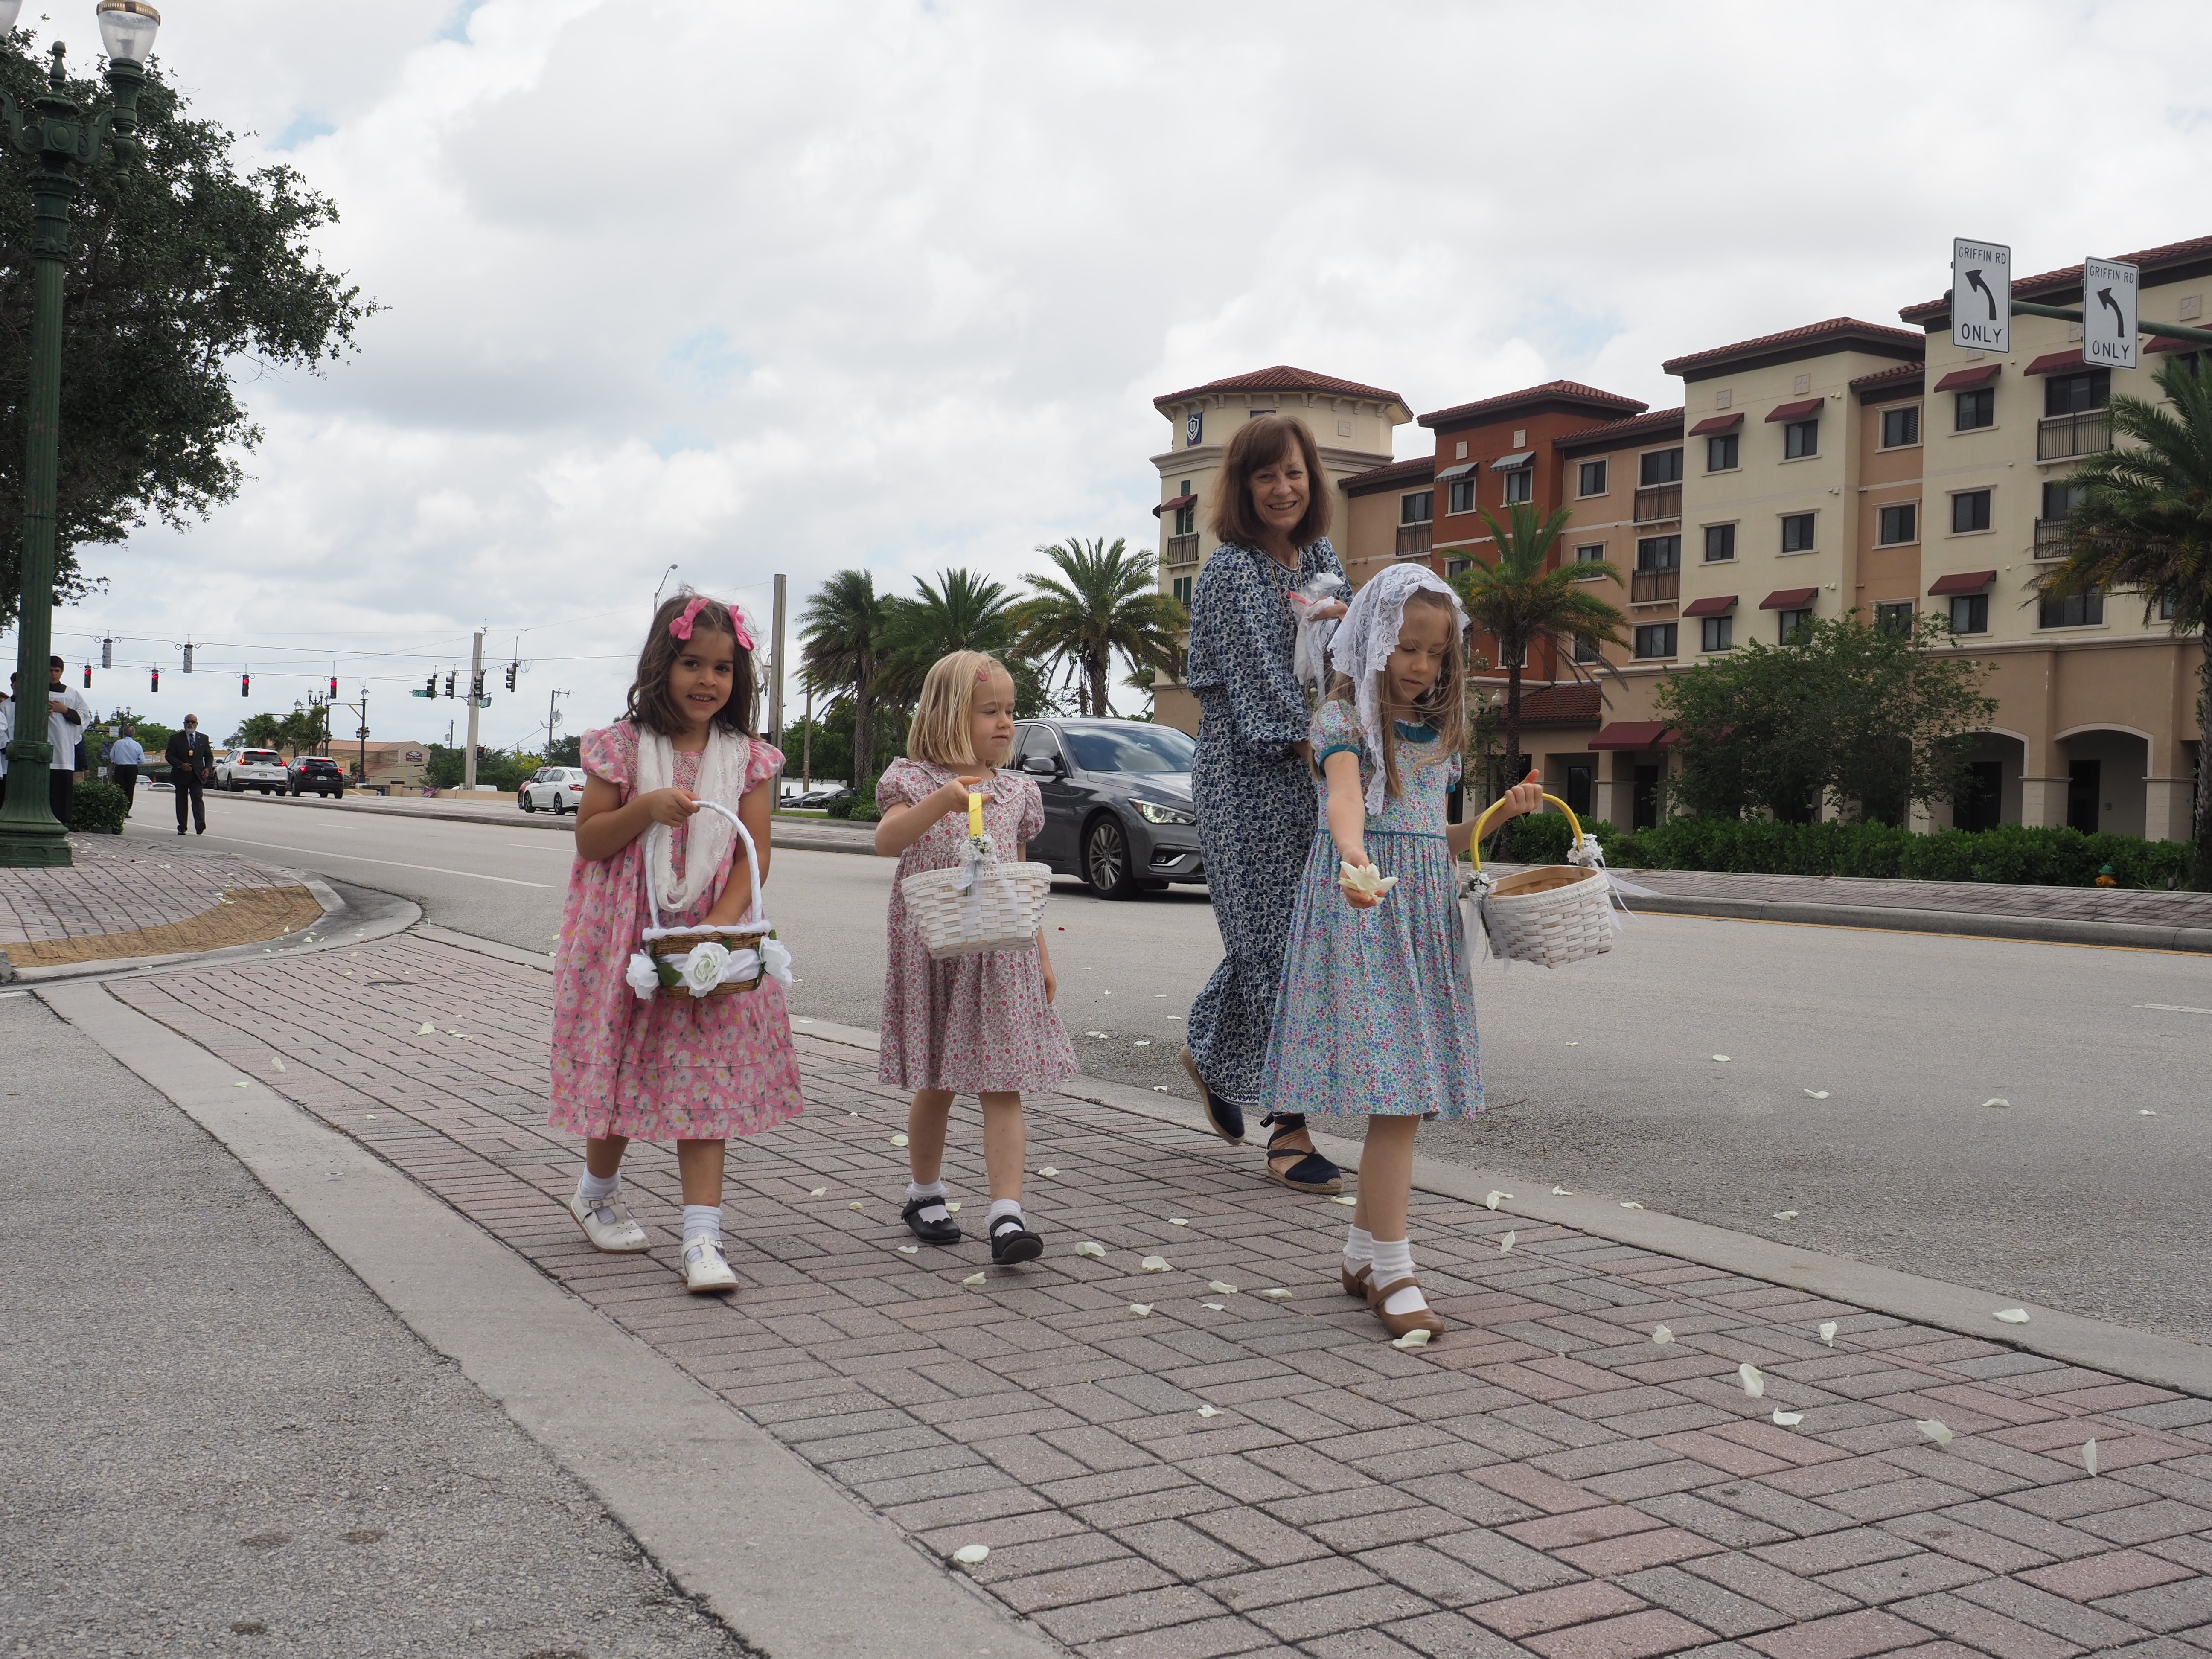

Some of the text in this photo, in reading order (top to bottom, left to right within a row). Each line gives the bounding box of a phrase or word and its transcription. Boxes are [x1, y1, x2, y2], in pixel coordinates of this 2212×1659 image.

[1959, 247, 2006, 264] GRIFFIN RD
[2090, 265, 2134, 283] GRIFFIN RD
[1961, 323, 2002, 344] ONLY
[2092, 340, 2130, 360] ONLY
